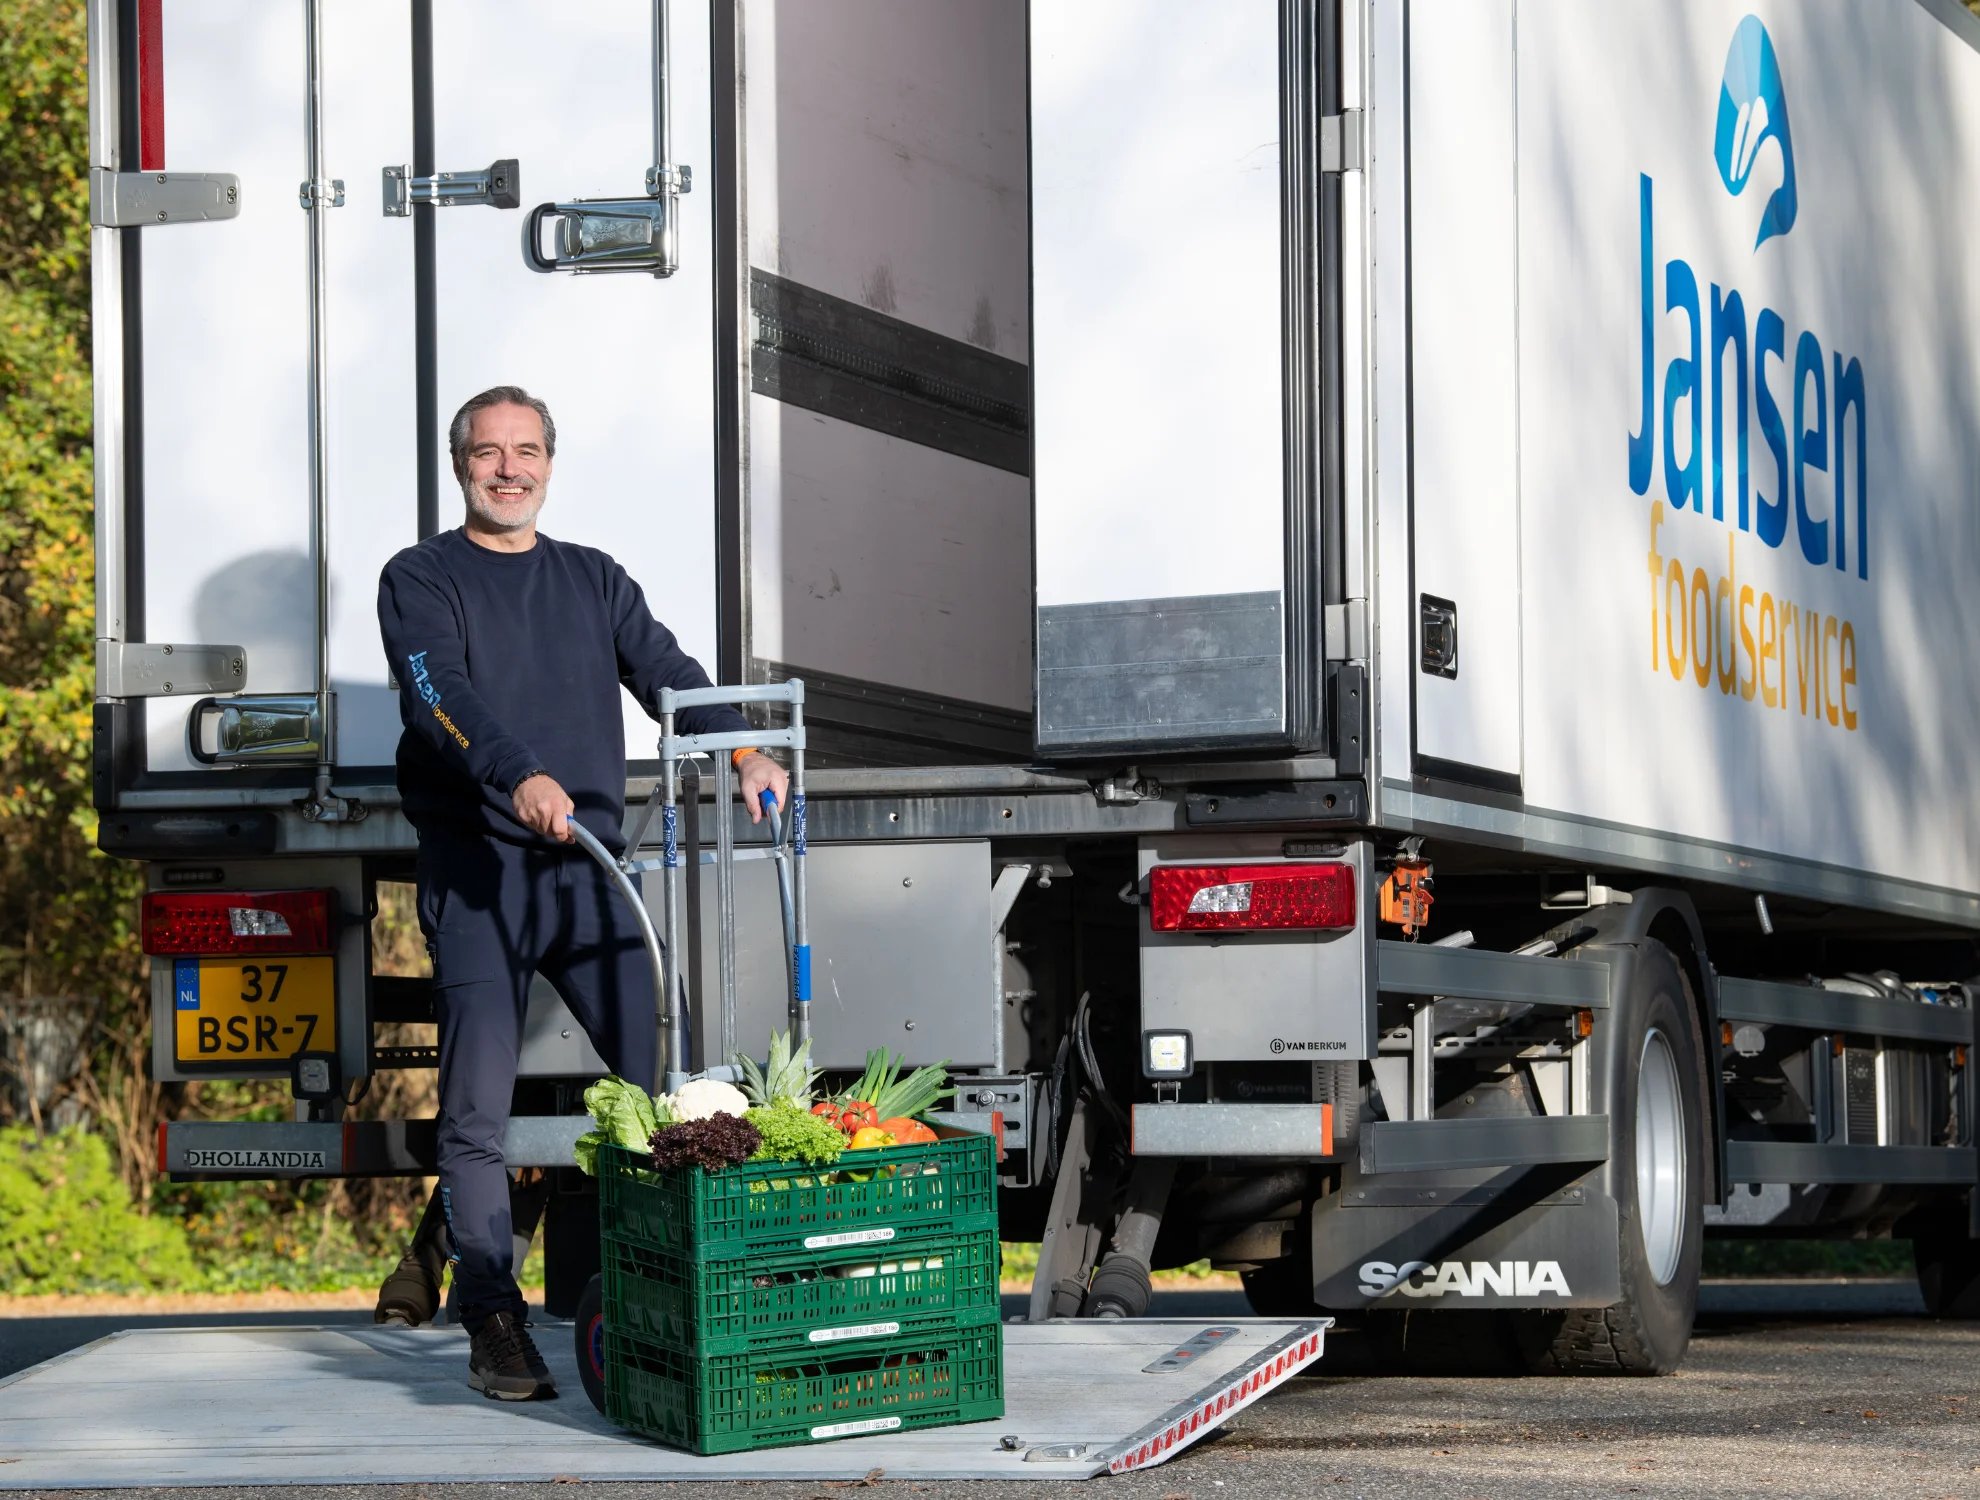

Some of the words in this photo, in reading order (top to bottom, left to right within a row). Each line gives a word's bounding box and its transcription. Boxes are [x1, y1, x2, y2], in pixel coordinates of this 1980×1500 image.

[1628, 171, 1869, 582] Jansen
[1647, 499, 1858, 732] foodservice
[432, 704, 470, 749] foodservice
[180, 990, 197, 1002] NL
[240, 964, 288, 1003] 37
[198, 1014, 319, 1053] BSR-7
[1286, 1042, 1305, 1050] VAN
[1307, 1041, 1347, 1050] BERKUM
[190, 1151, 324, 1168] DHOLLANDIA
[1358, 1260, 1572, 1298] SCANIA
